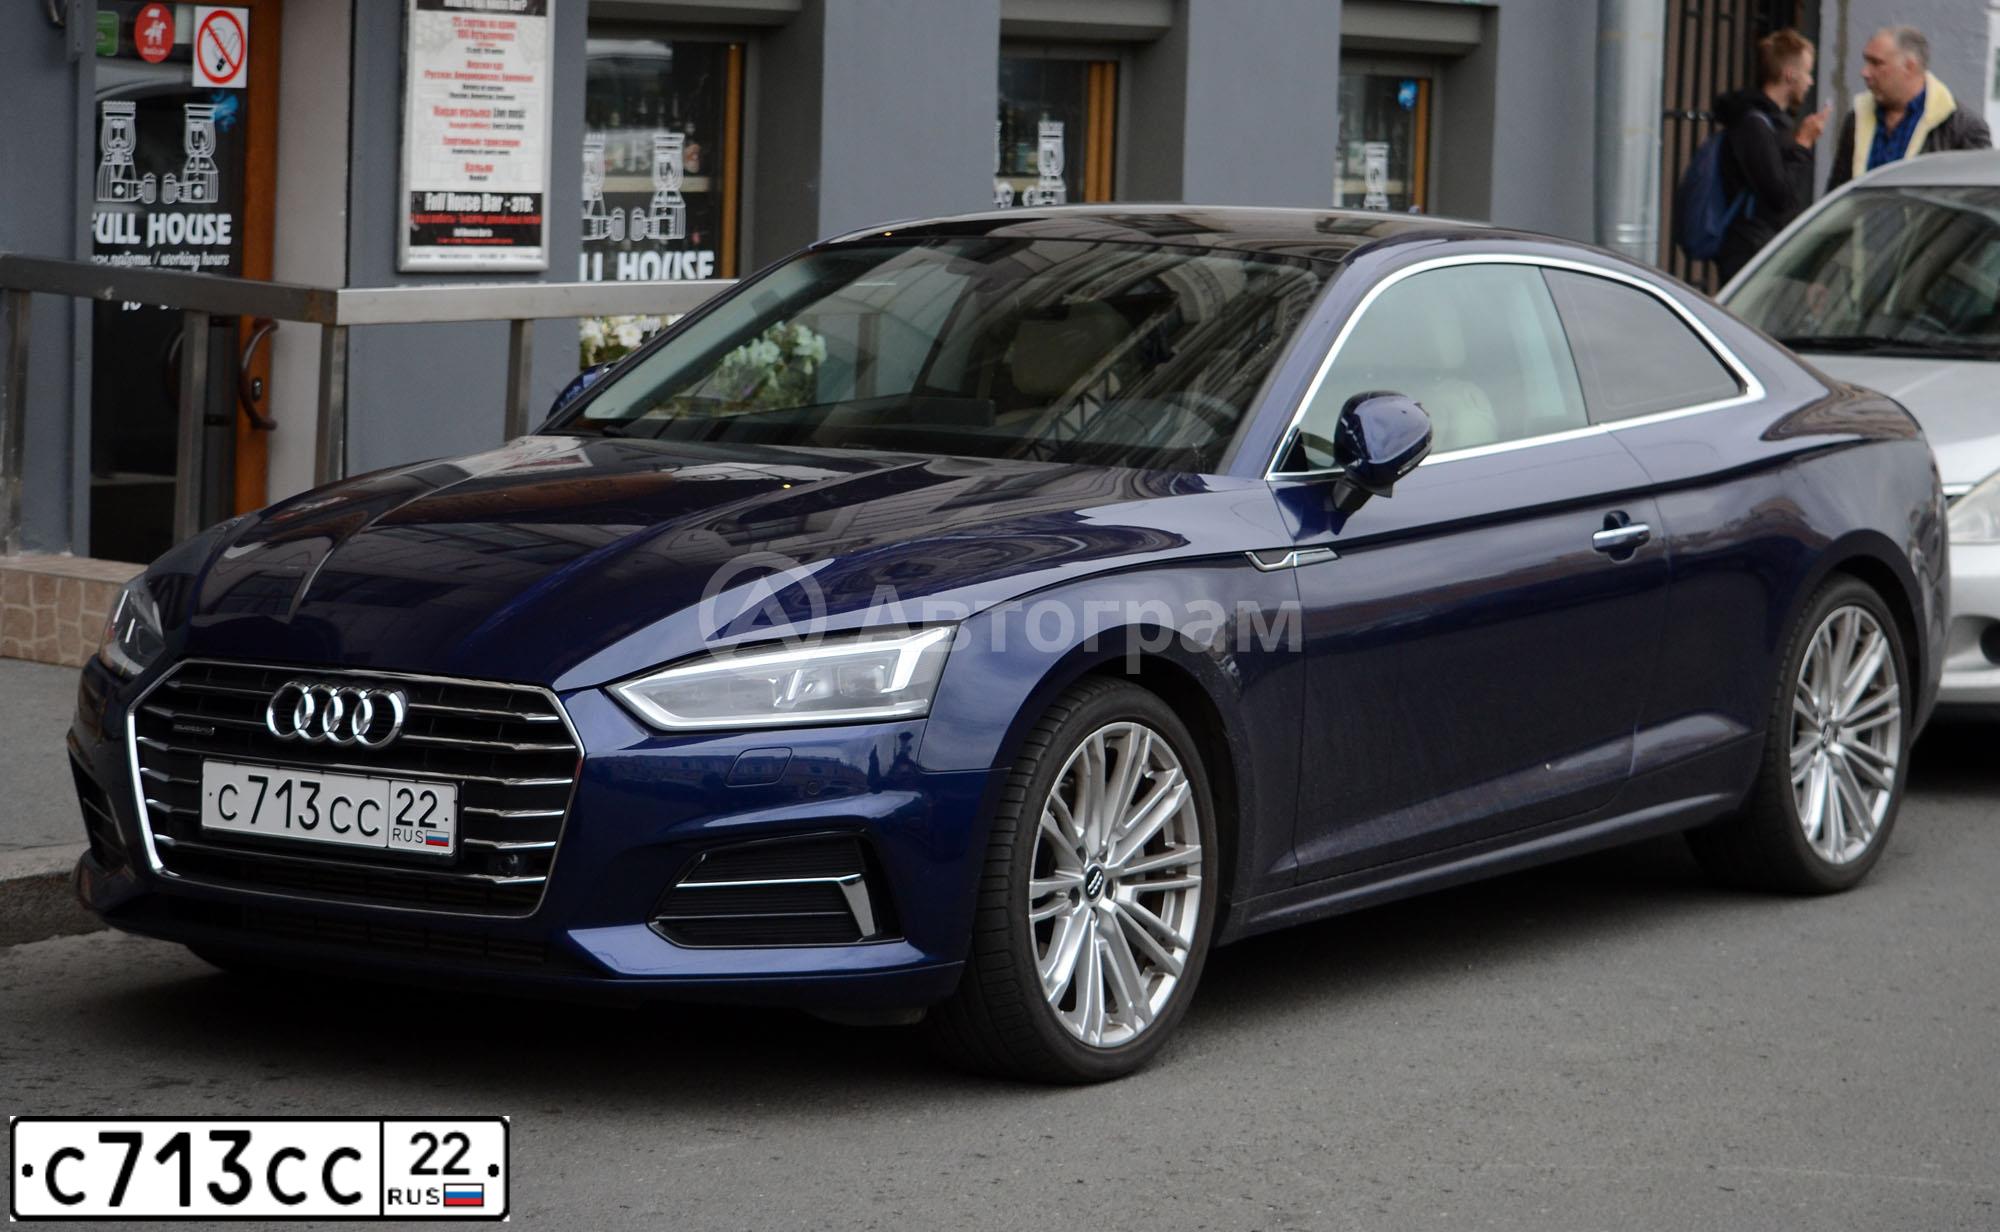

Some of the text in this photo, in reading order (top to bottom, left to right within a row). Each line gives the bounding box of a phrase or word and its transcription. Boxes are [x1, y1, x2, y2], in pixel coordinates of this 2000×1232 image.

[424, 192, 446, 211] Full
[446, 192, 481, 212] House
[481, 193, 503, 212] Bar
[147, 212, 232, 248] HOUSE
[159, 251, 201, 272] working
[200, 251, 230, 266] hours
[395, 787, 438, 829] 22
[391, 827, 424, 844] RUS
